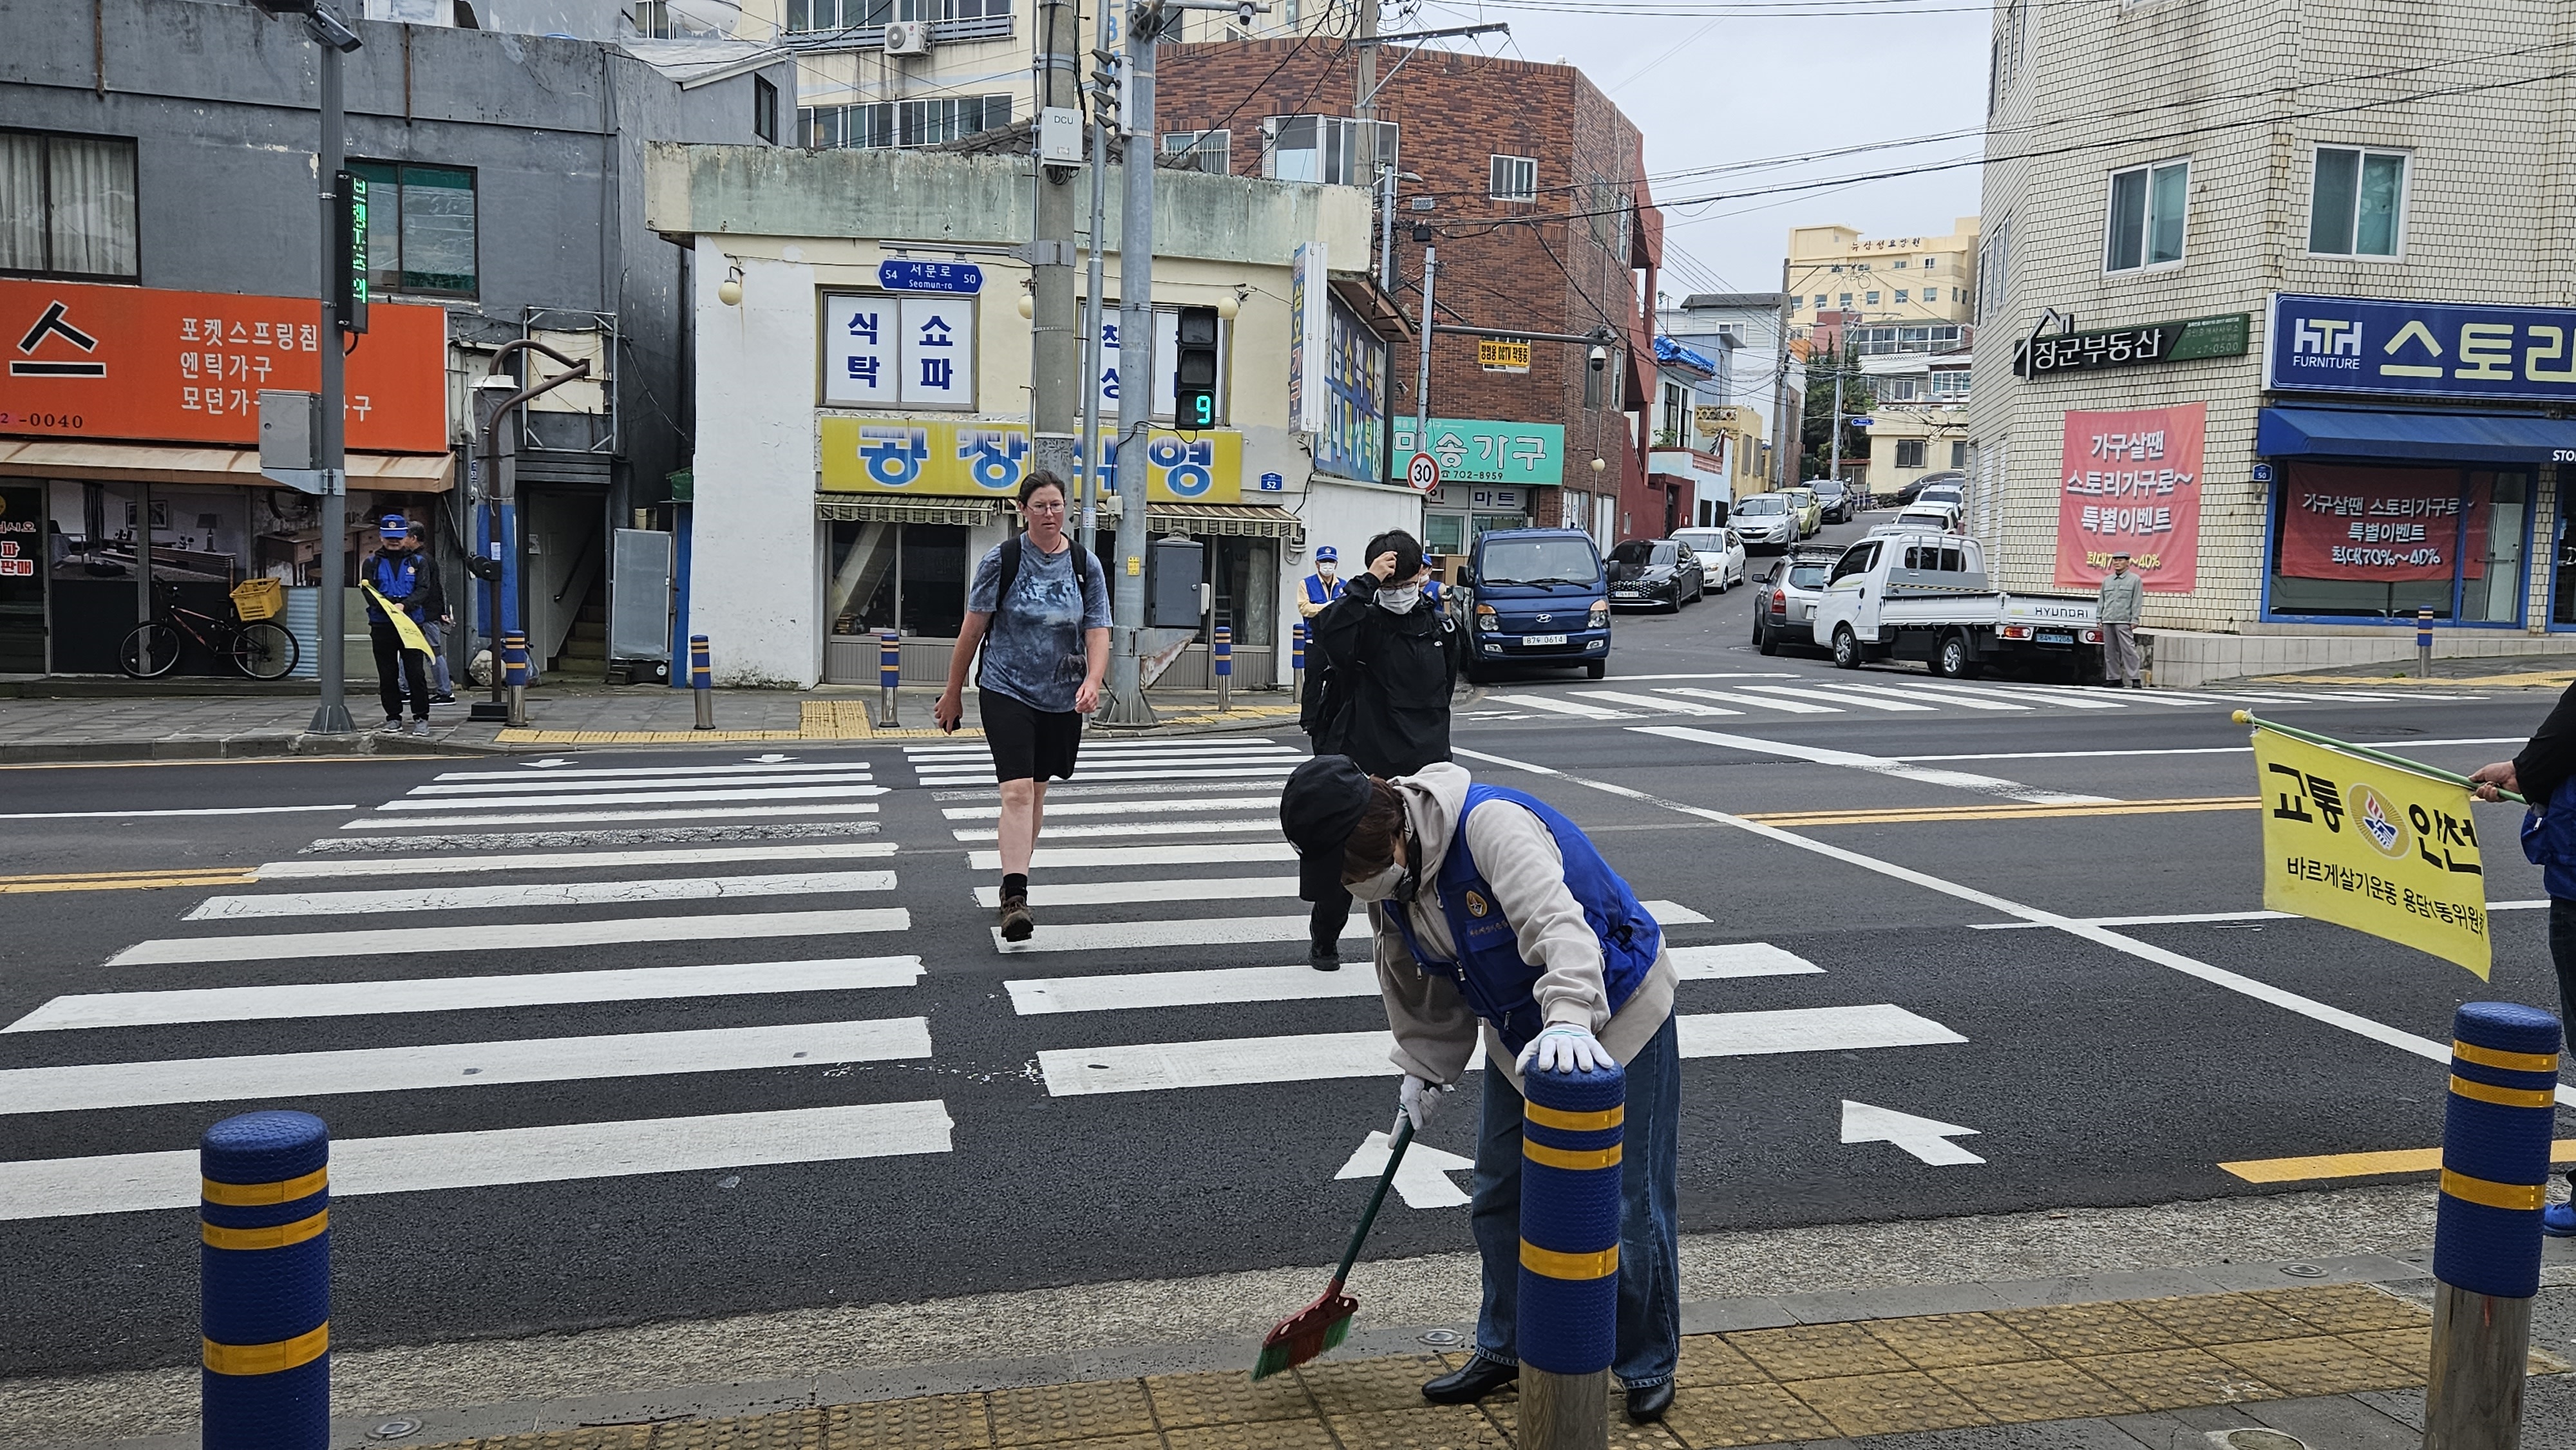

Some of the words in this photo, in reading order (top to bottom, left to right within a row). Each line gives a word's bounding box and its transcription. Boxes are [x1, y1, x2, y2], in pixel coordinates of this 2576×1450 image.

[1054, 115, 1074, 125] DCU
[886, 270, 897, 279] 54
[910, 264, 952, 278] 서문로
[963, 274, 976, 283] 50
[909, 279, 952, 289] Seomun-ro
[1290, 281, 1304, 411] 삼오가구
[1481, 344, 1497, 361] 방범용
[1499, 346, 1511, 361] CCTV
[1513, 347, 1528, 363] 작동중
[2034, 328, 2162, 370] 장군부동산
[180, 352, 272, 383] 엔틱가구
[2293, 355, 2360, 370] FURNITURE
[181, 387, 261, 417] 모던가
[1196, 395, 1211, 425] 9
[1394, 431, 1547, 471] 미송가구
[2091, 430, 2165, 461] 가구살땐
[1414, 464, 1432, 482] 30
[1453, 470, 1503, 480] 702-8959
[1474, 491, 1515, 507] 마트
[2302, 493, 2364, 516] 가구살땐
[2081, 505, 2173, 534] 특별이벤트
[2347, 522, 2426, 542] 특별이벤트
[0, 560, 33, 576] 판매
[2035, 607, 2088, 618] HYUNDAI
[2268, 762, 2345, 833] 교통
[2408, 803, 2483, 876] 안전
[2287, 856, 2398, 907] 바르게살기운동
